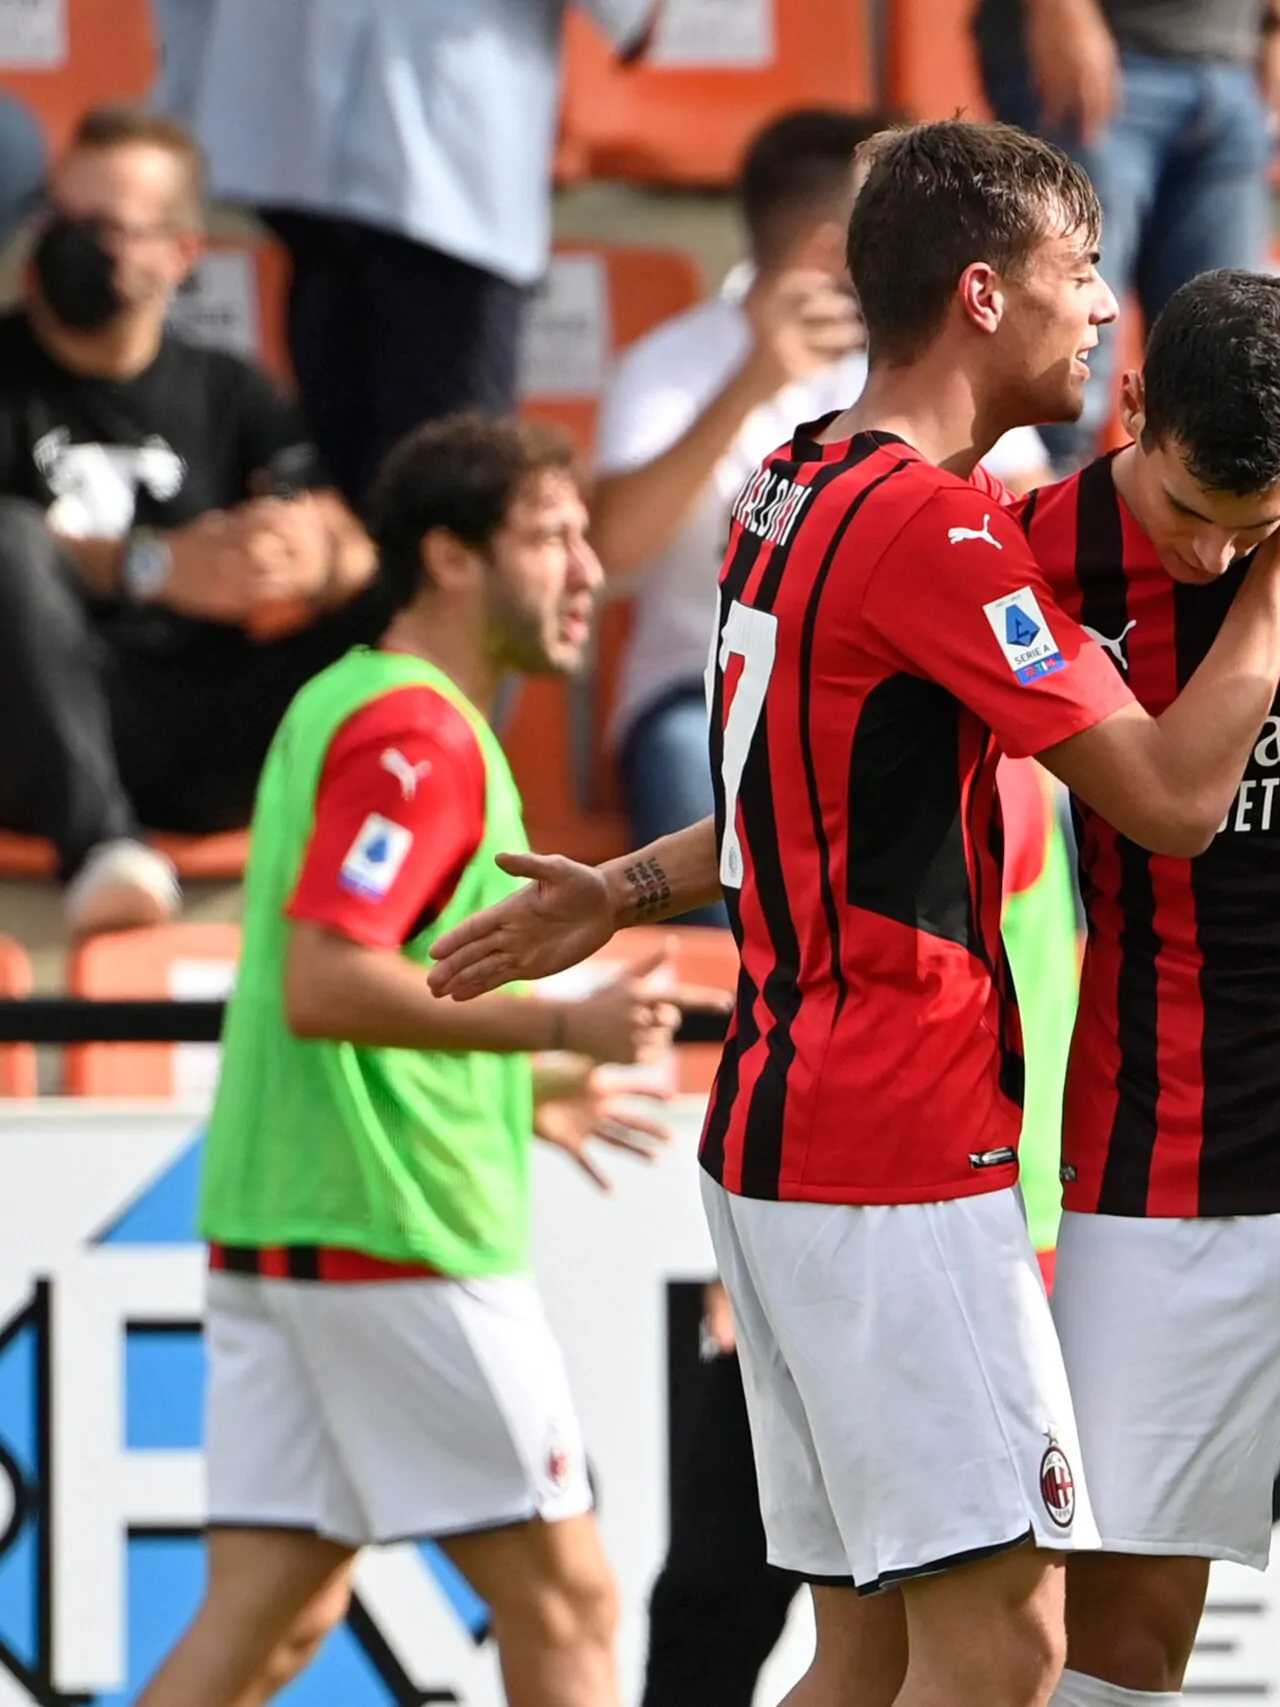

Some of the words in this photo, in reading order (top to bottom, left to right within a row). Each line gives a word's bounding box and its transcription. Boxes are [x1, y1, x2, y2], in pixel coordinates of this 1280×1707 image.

[704, 578, 778, 889] 7
[1014, 648, 1042, 666] SERIE
[1043, 644, 1051, 653] A
